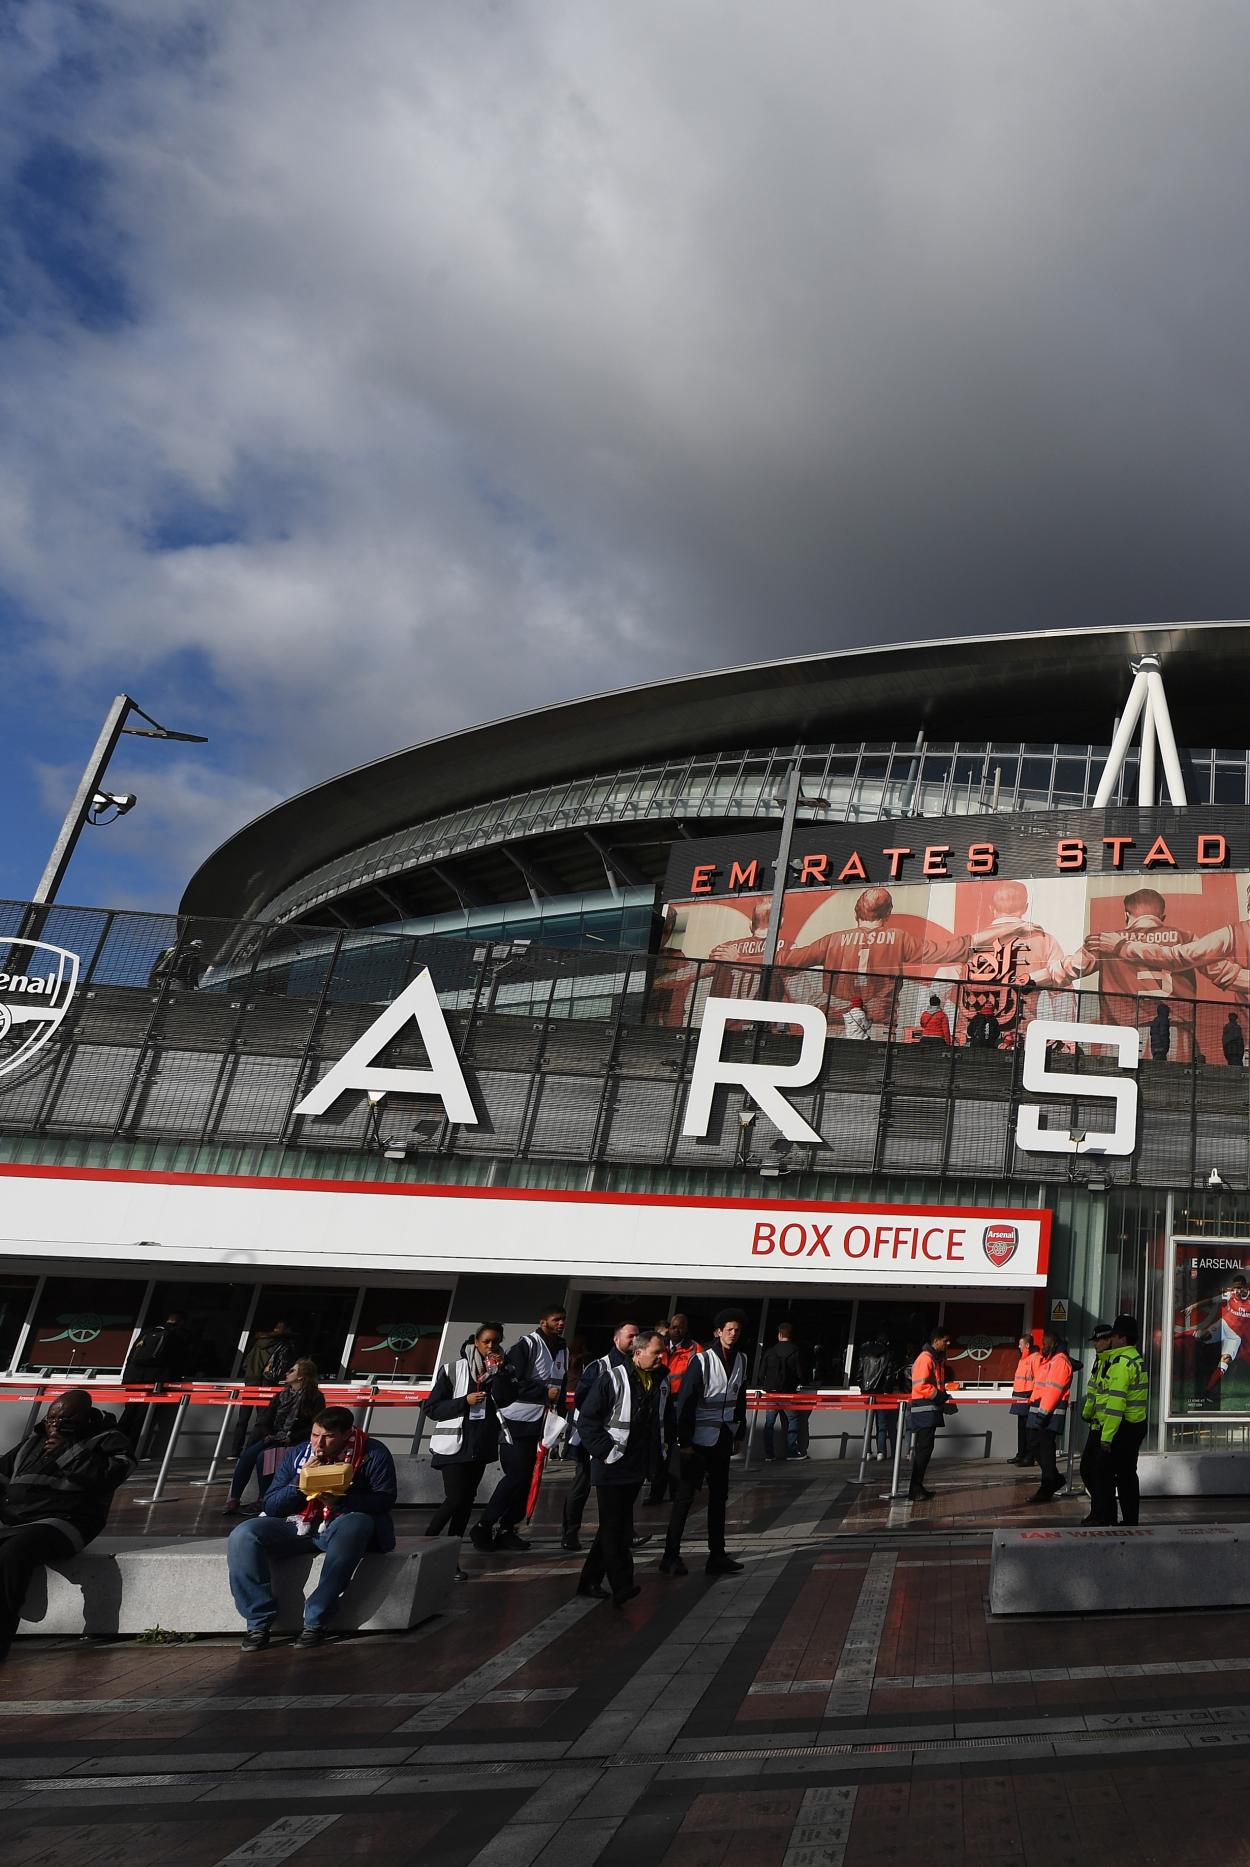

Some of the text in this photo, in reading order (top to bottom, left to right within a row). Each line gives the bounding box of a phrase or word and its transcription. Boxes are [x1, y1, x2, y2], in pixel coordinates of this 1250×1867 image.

[690, 843, 994, 892] EMRATES
[840, 931, 897, 947] WILSON
[751, 1222, 967, 1261] BOX OFFICE
[988, 1231, 1014, 1239] Arsenal
[1199, 1258, 1245, 1270] ARSENAL
[1020, 1528, 1154, 1539] IAN WRIGHT
